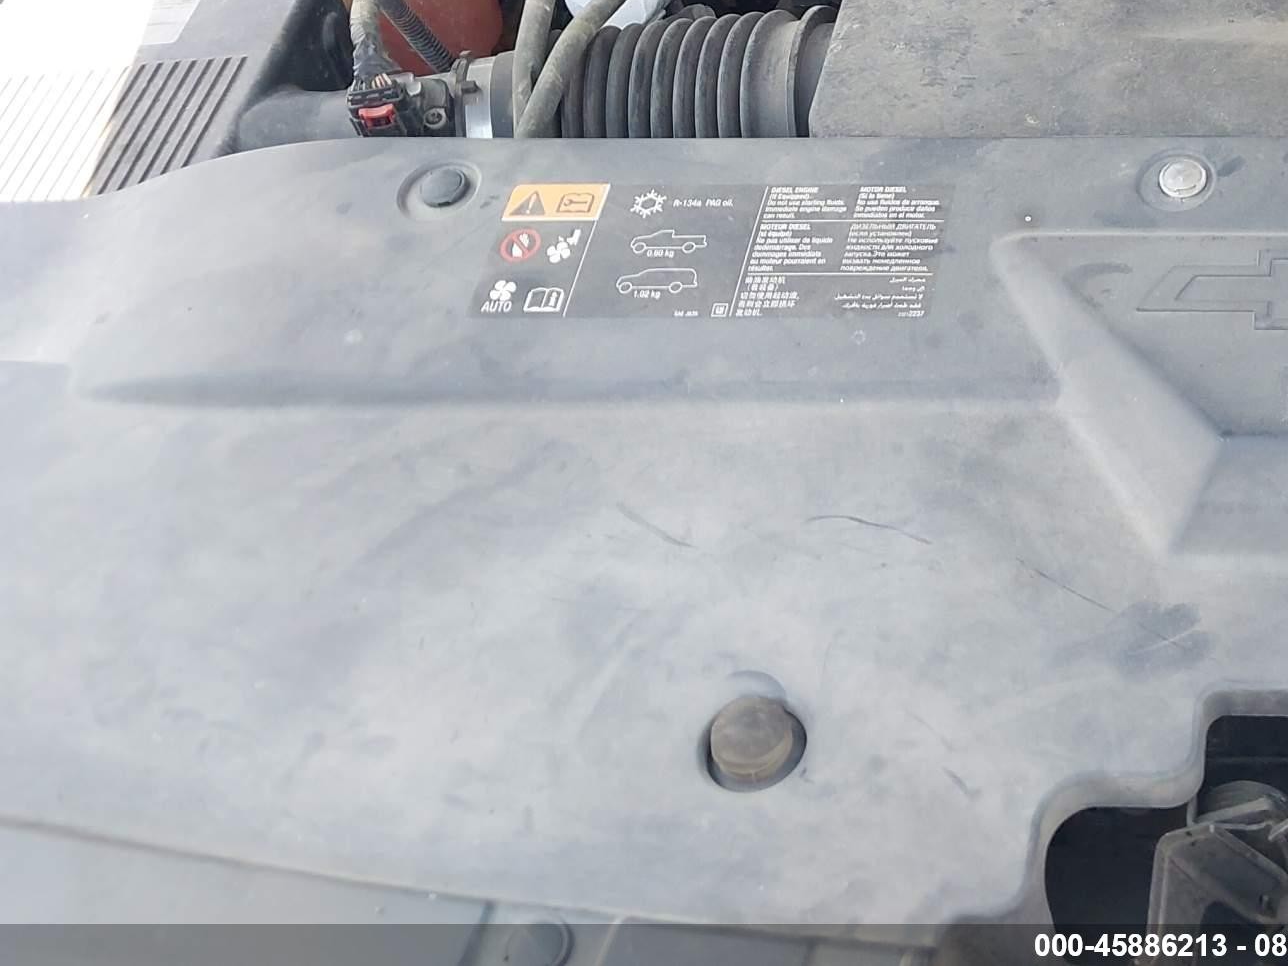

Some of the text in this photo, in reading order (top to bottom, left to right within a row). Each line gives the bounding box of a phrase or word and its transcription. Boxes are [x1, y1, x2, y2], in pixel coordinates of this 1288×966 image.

[771, 186, 819, 194] DIESEL ENGINE
[672, 198, 702, 208] R-134a
[705, 198, 721, 207] PAG
[664, 248, 675, 259] kg
[633, 290, 661, 300] 1.02 kg
[480, 300, 512, 313] AUTO
